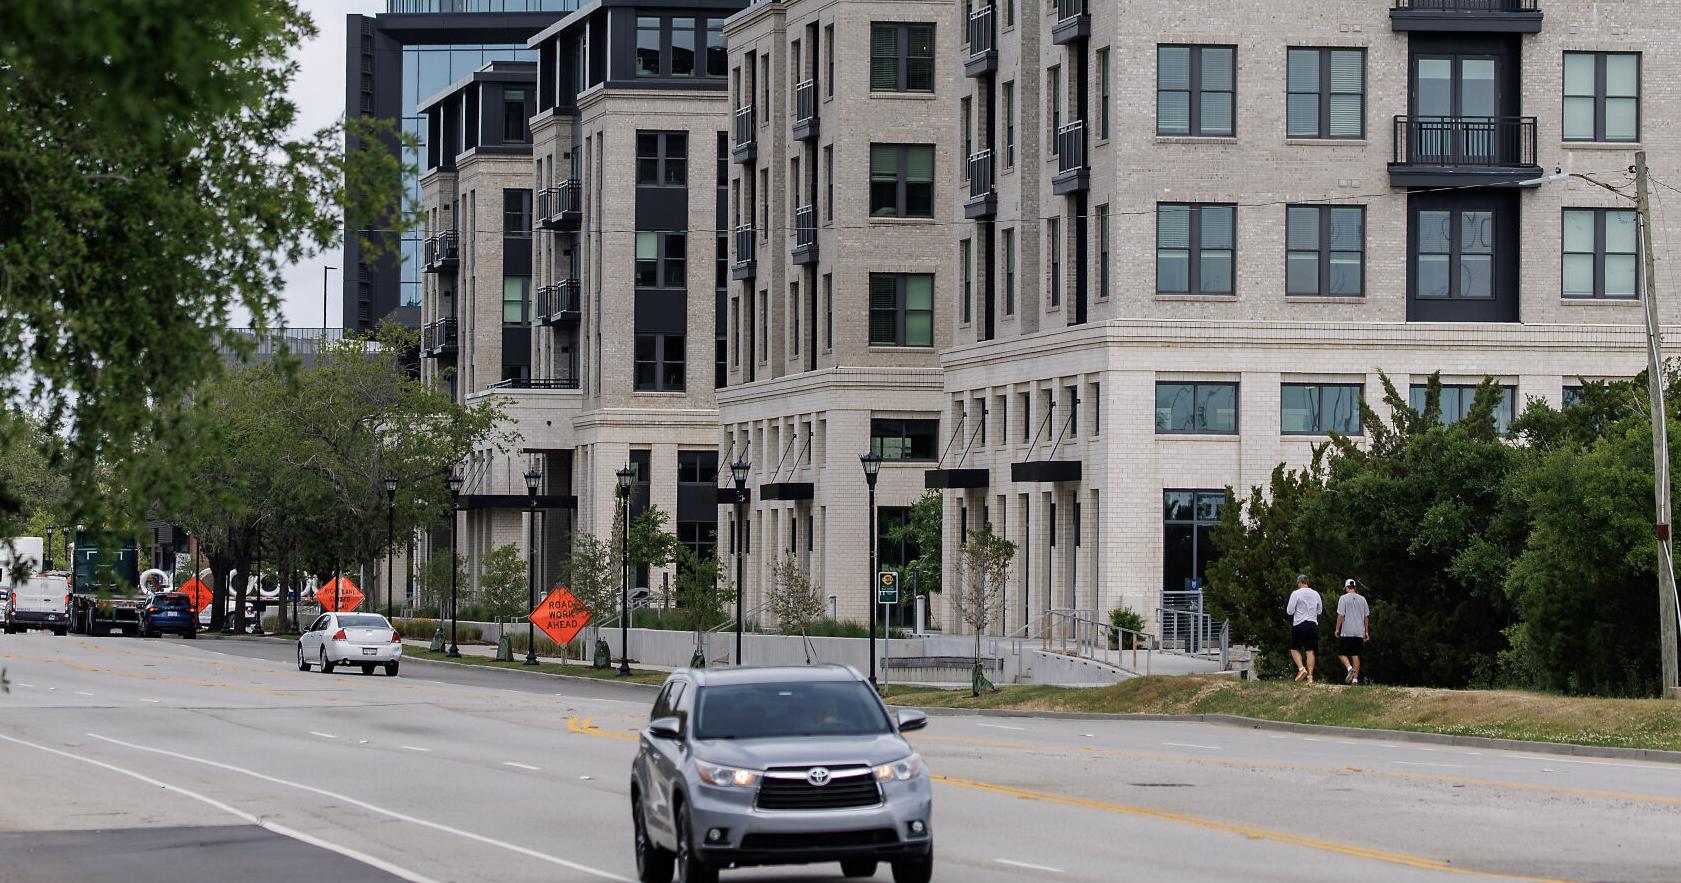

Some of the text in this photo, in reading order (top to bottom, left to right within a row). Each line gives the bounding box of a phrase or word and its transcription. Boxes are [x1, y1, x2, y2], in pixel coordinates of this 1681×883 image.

[549, 600, 574, 609] ROAD
[549, 610, 575, 619] WORK
[547, 620, 577, 630] AHEAD
